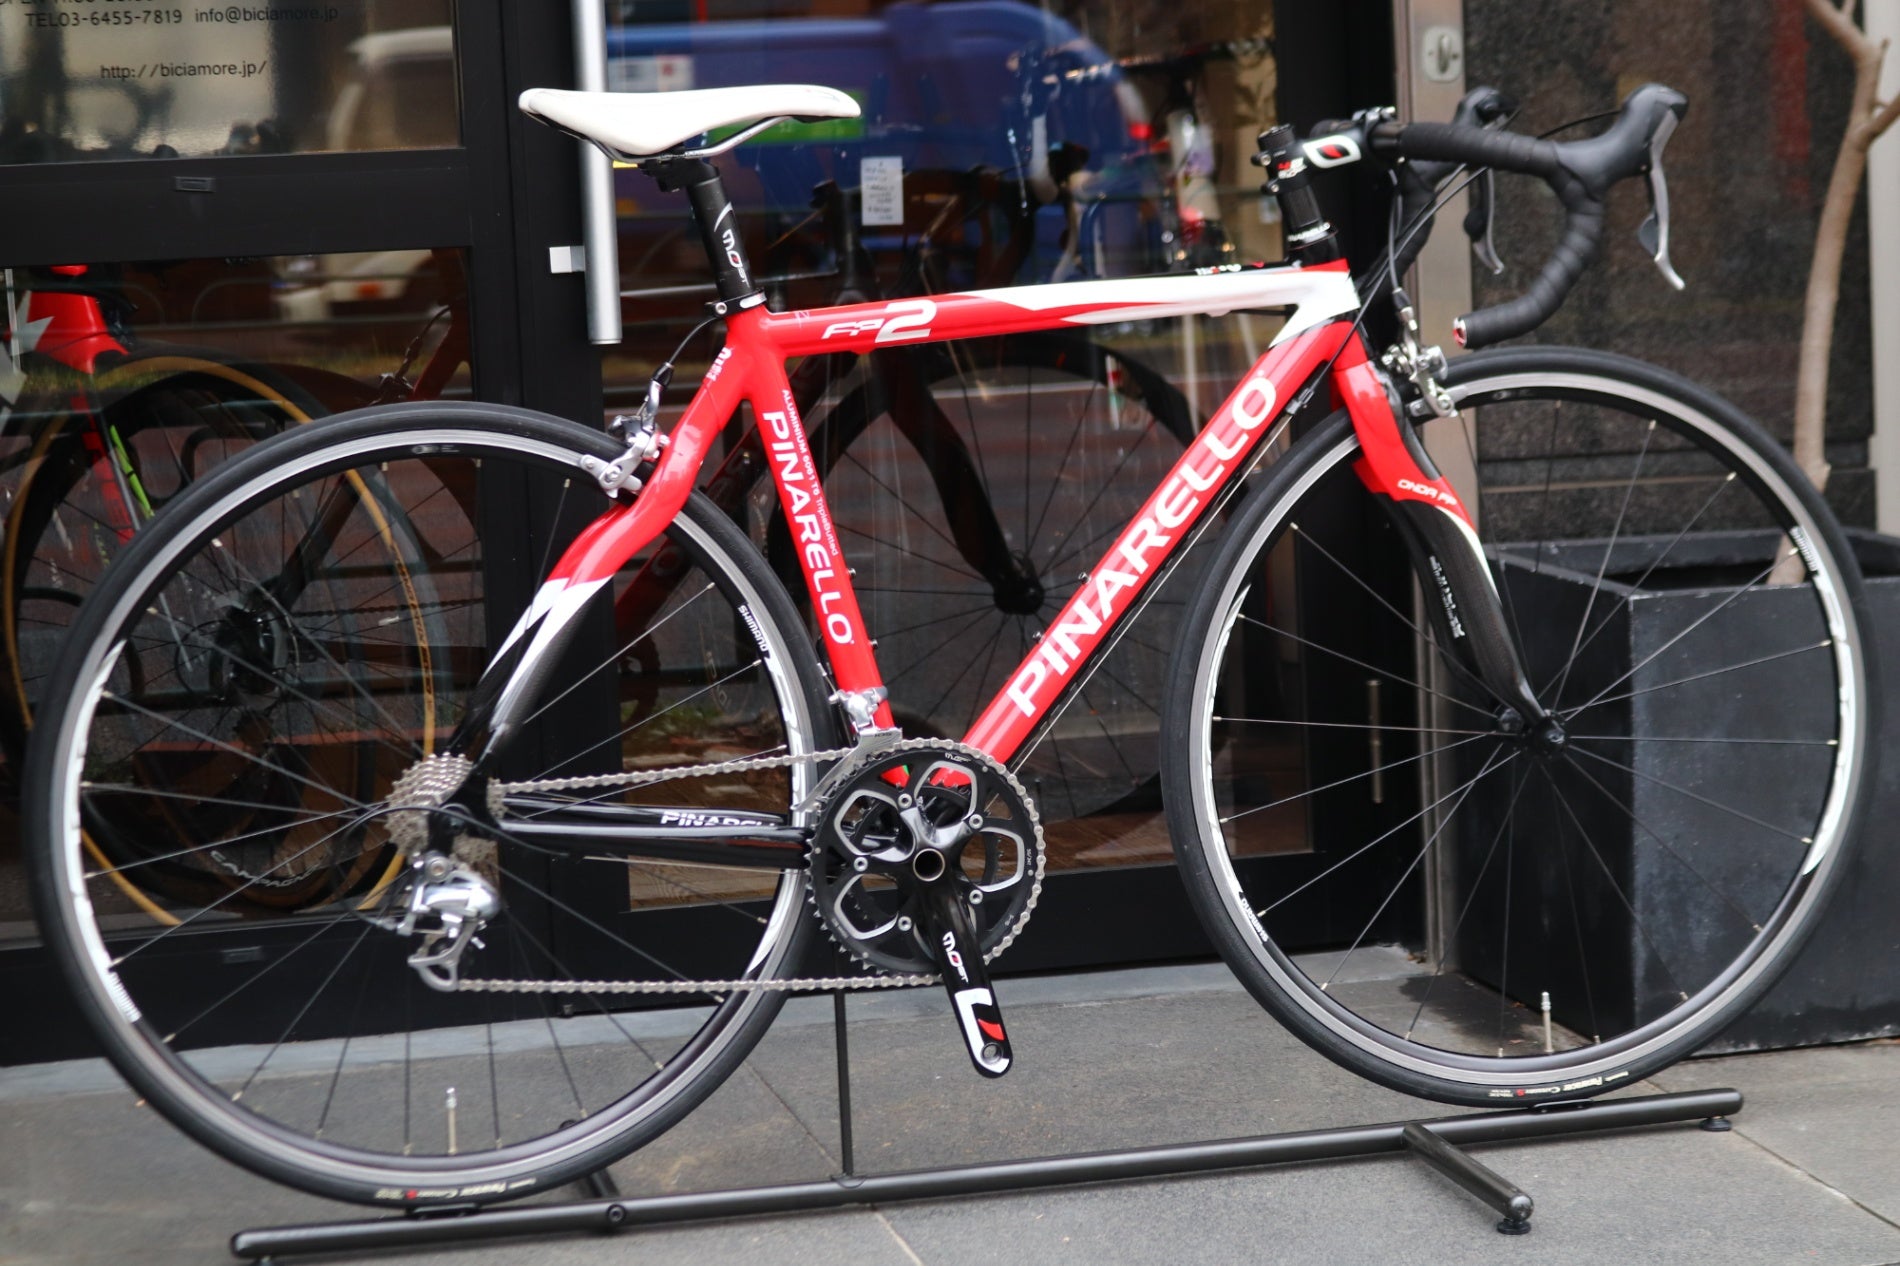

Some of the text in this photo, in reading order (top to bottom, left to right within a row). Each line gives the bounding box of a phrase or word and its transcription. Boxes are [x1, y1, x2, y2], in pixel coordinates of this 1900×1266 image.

[195, 6, 338, 24] info@biciamore.jp
[101, 59, 267, 80] http://biciamore.jp/
[782, 388, 807, 455] ALUMINIUM
[763, 410, 854, 645] PINARELLO
[1006, 375, 1277, 718] PINARELLO
[737, 604, 769, 652] SHIMANO
